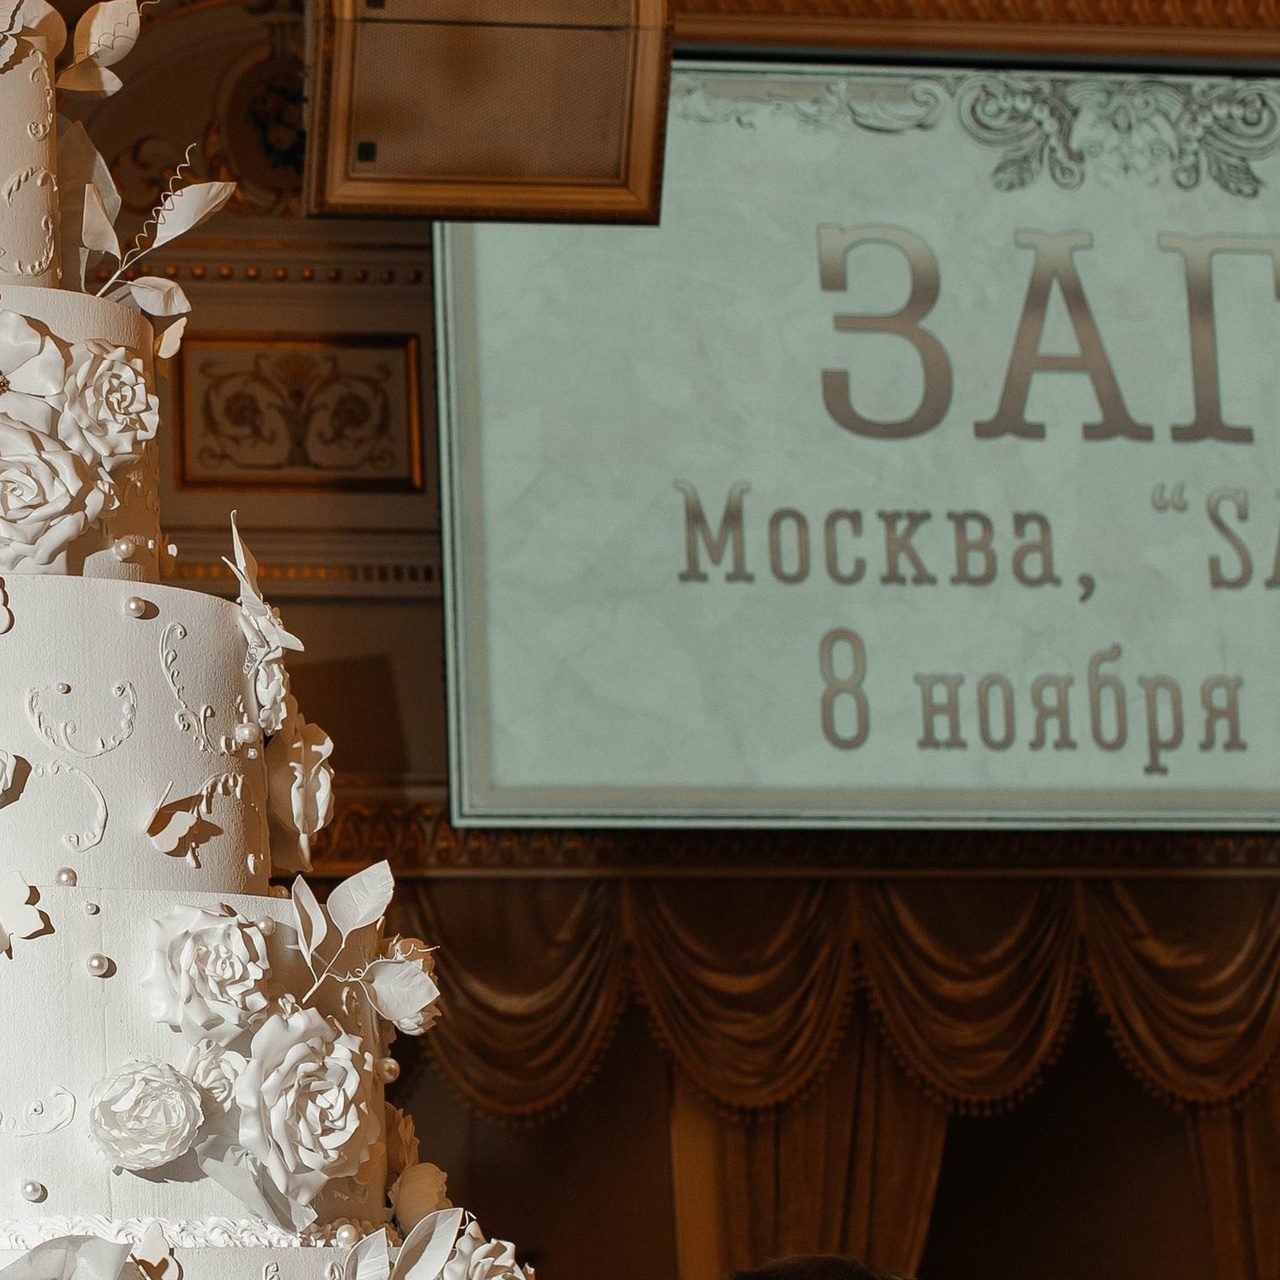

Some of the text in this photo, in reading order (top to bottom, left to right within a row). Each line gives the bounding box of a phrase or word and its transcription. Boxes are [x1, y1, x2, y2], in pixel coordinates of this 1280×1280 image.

[673, 479, 1280, 603] Москва, “S
[818, 626, 1248, 776] 8 ноября
